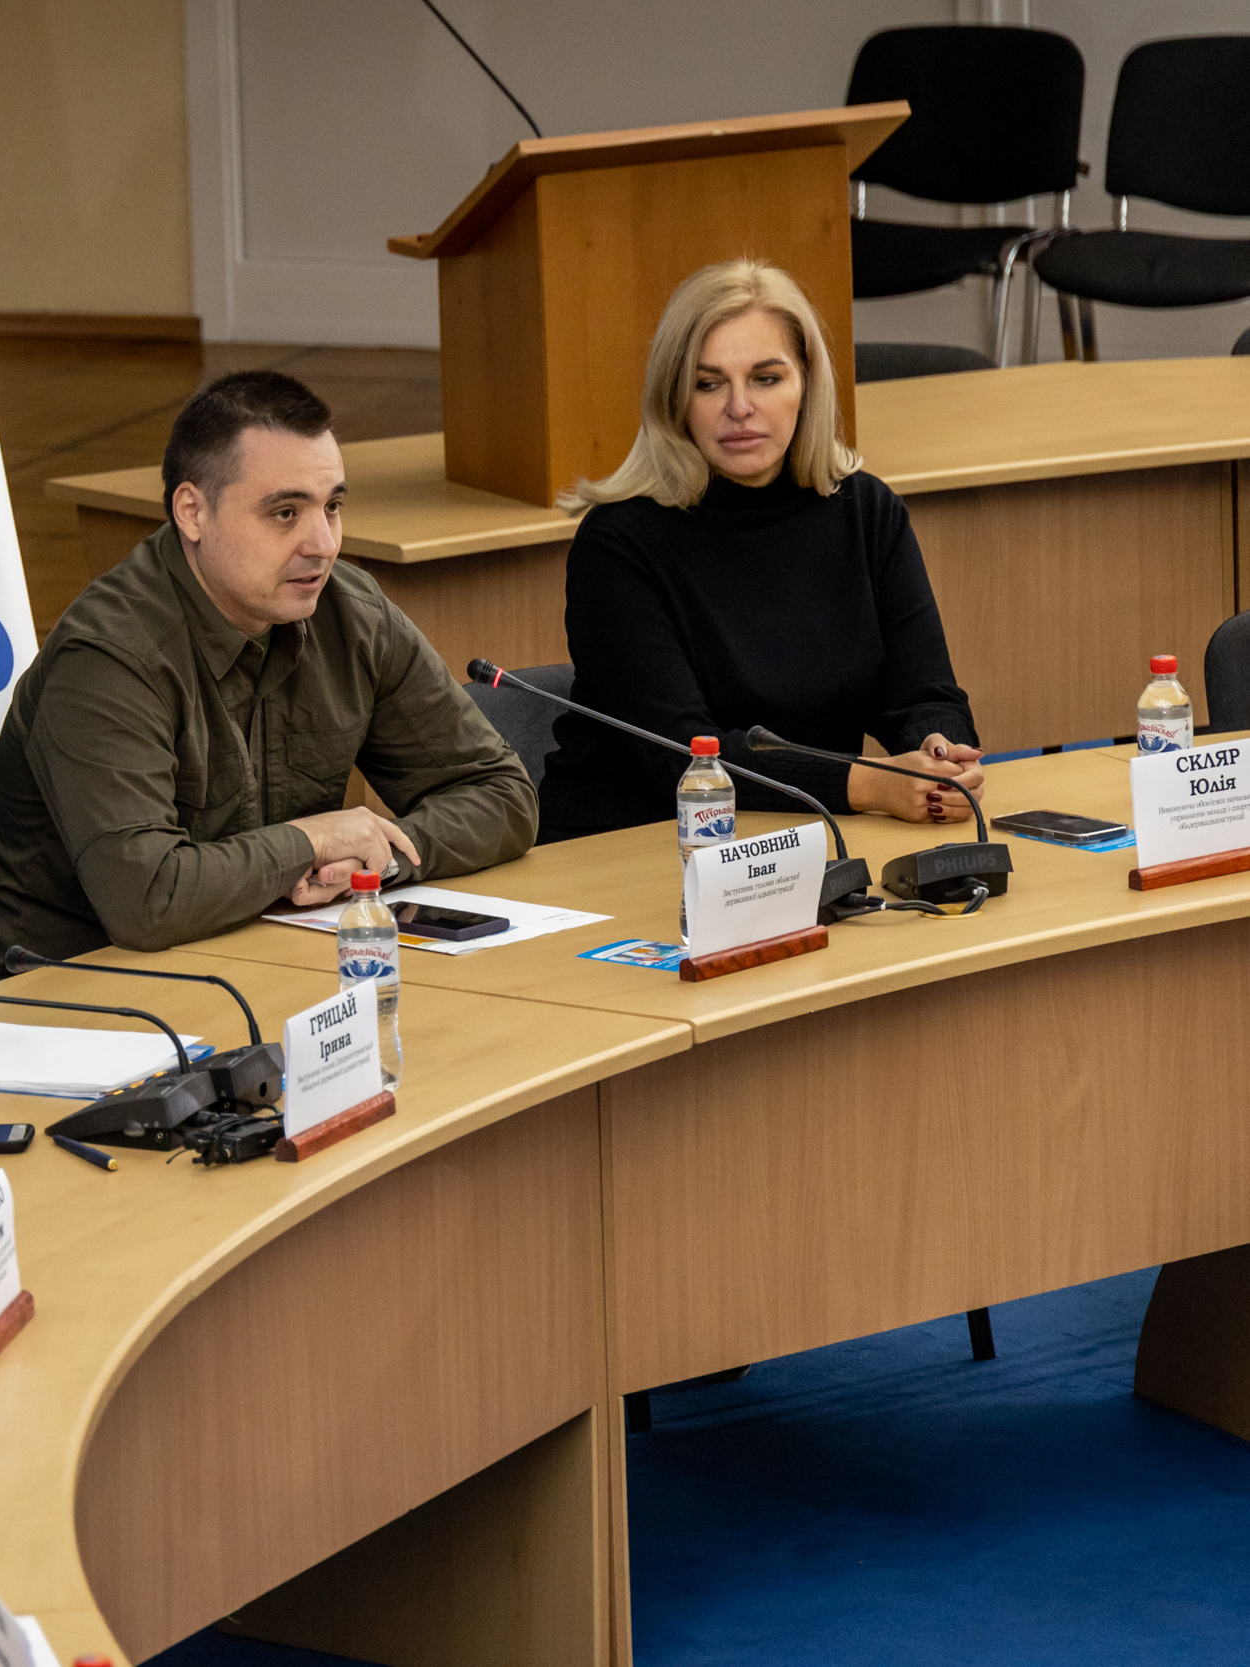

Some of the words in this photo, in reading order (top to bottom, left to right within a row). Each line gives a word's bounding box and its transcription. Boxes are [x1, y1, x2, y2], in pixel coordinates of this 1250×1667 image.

[1176, 748, 1240, 773] СКЛЯР
[1189, 774, 1237, 796] Юлія
[719, 829, 800, 863] НАЧОВНИЙ
[748, 863, 776, 879] Іван
[934, 852, 997, 874] PHILIPS
[309, 991, 357, 1036] ГРИЦАЙ
[320, 1033, 351, 1062] Ірина
